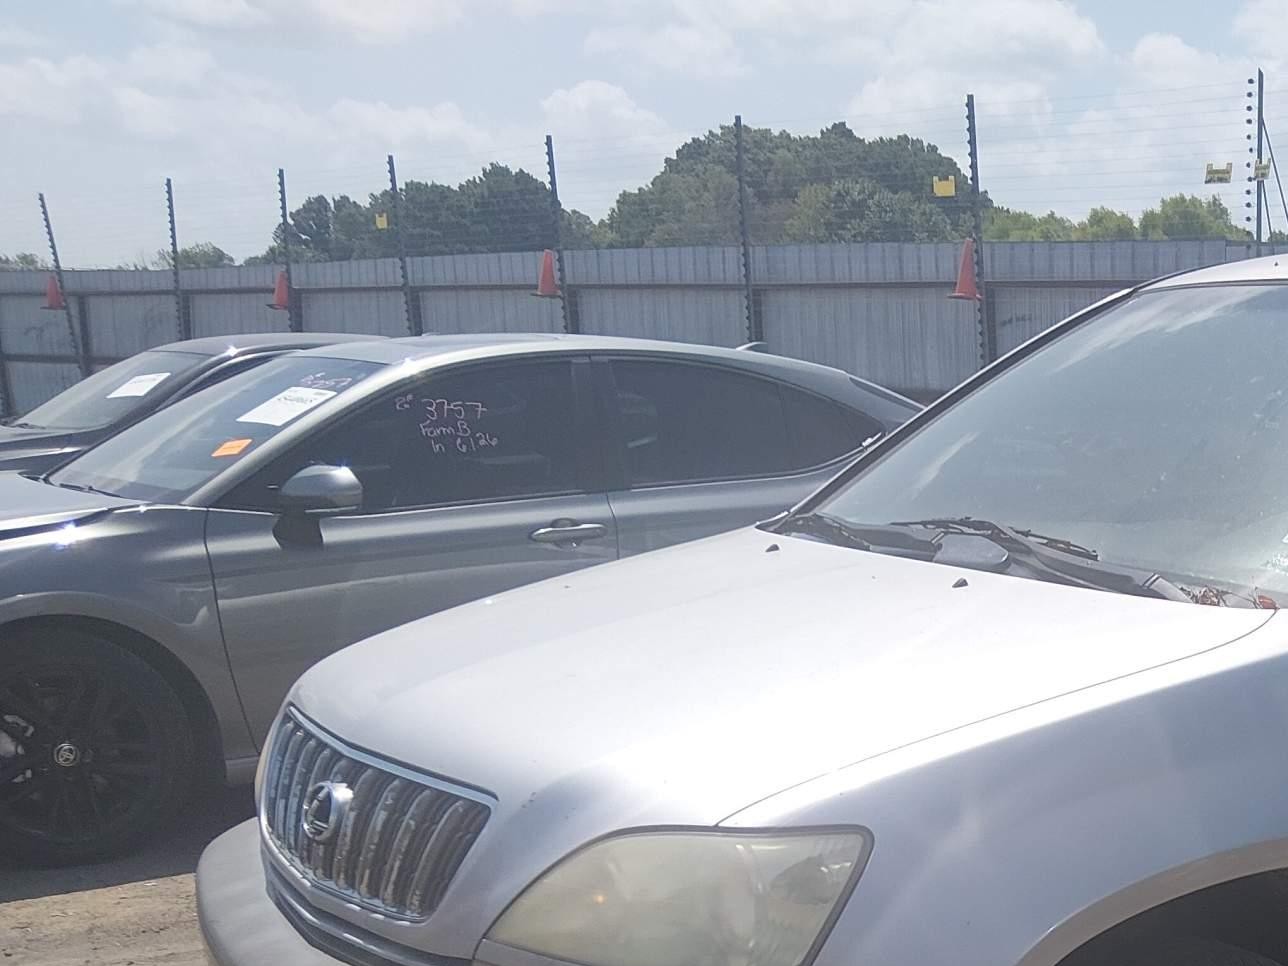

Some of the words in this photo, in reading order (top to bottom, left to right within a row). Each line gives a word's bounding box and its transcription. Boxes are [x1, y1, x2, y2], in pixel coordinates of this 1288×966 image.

[421, 399, 487, 420] 3757
[419, 420, 455, 437] Farm
[456, 420, 471, 436] B
